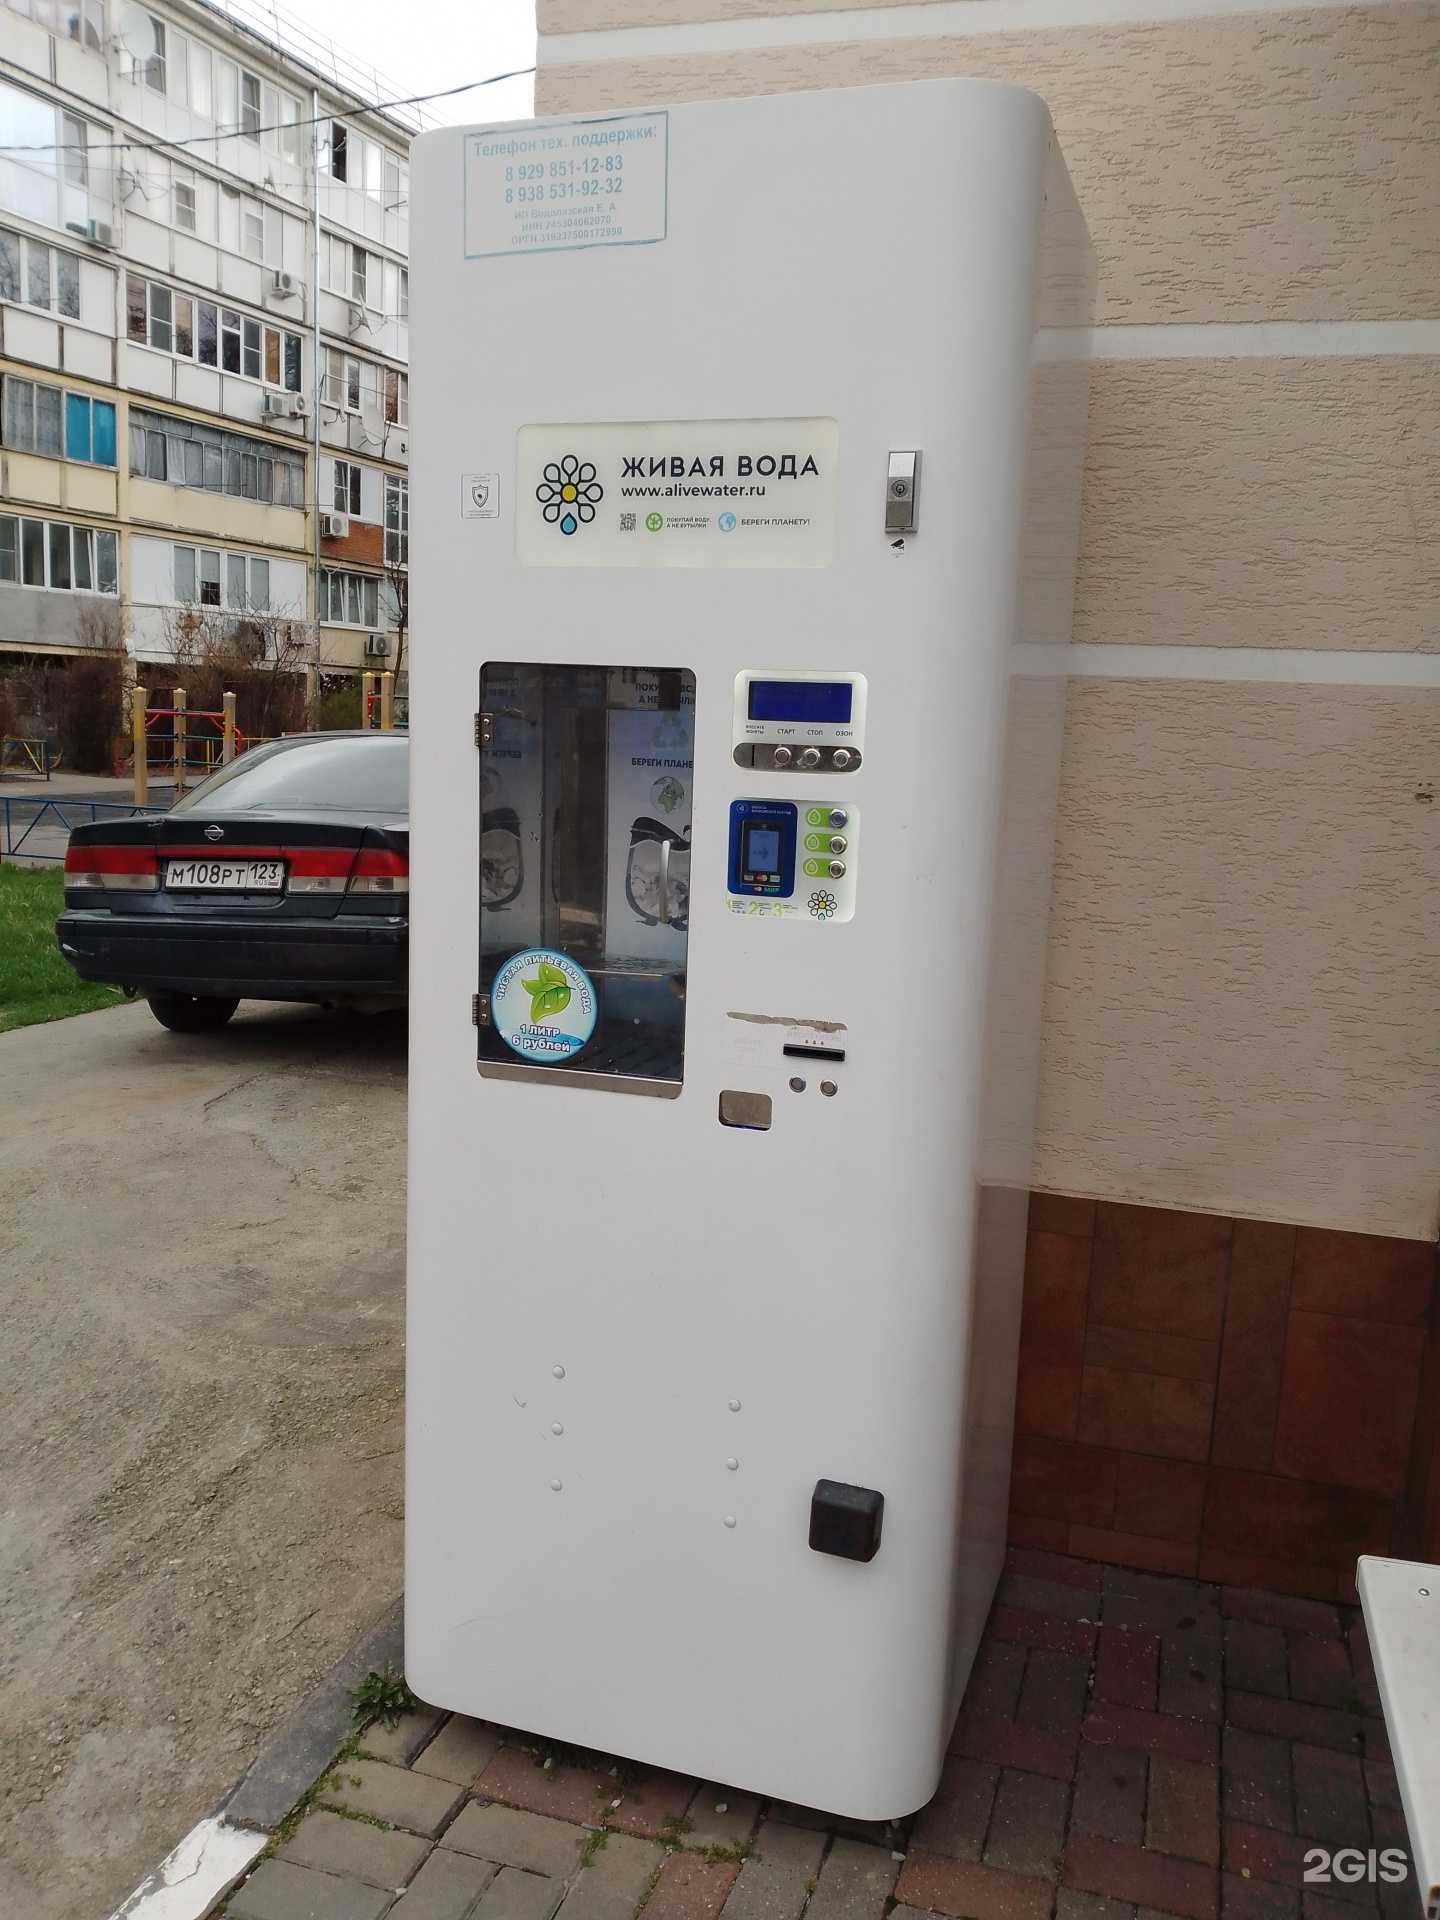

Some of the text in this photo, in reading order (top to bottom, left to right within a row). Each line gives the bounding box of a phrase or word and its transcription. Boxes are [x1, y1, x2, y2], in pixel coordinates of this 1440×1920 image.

[474, 126, 657, 157] Телефон тех. поддержки:
[505, 155, 623, 181] 8 929 851-12-83
[505, 177, 623, 204] 8 938 531-92-32
[621, 454, 819, 480] ЖИВАЯ ВОДА
[621, 484, 766, 498] www.alivewater.ru
[741, 518, 810, 526] БЕРЕГИ ПЛАНЕТУ!
[632, 758, 662, 767] БЕРЕГИ
[496, 955, 592, 1015] ЧИСТАЯ ПИТЬЕВАЯ ВОДА
[520, 1024, 527, 1034] 1
[512, 1035, 571, 1053] 6 рублей
